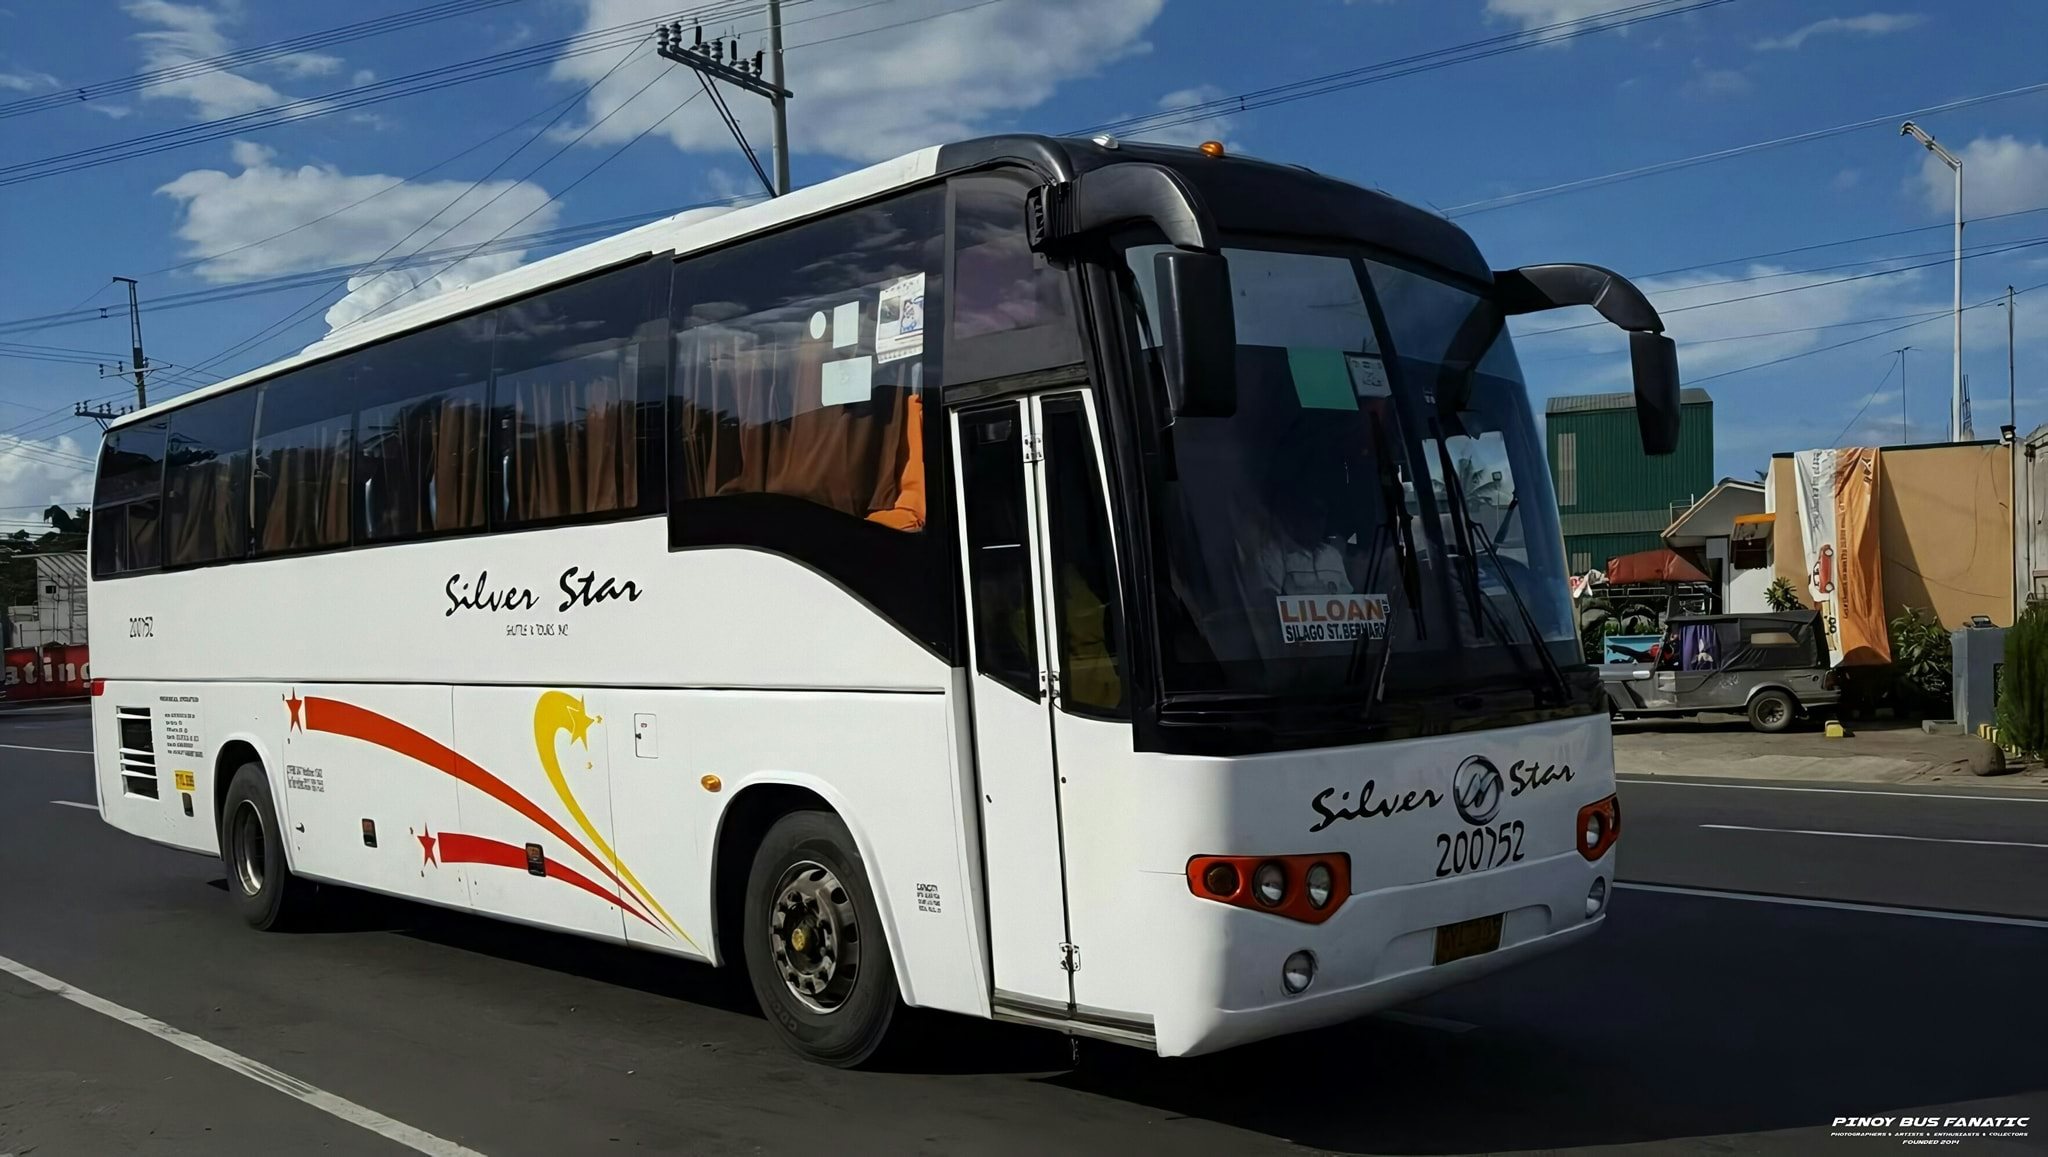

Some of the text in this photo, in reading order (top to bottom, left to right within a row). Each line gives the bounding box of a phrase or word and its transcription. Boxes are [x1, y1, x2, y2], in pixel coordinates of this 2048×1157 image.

[445, 566, 643, 617] Silver Star
[1280, 600, 1384, 622] LILOAN
[1285, 623, 1324, 641] SILAGO
[1309, 760, 1575, 832] Silver Star
[1436, 820, 1525, 877] 200752
